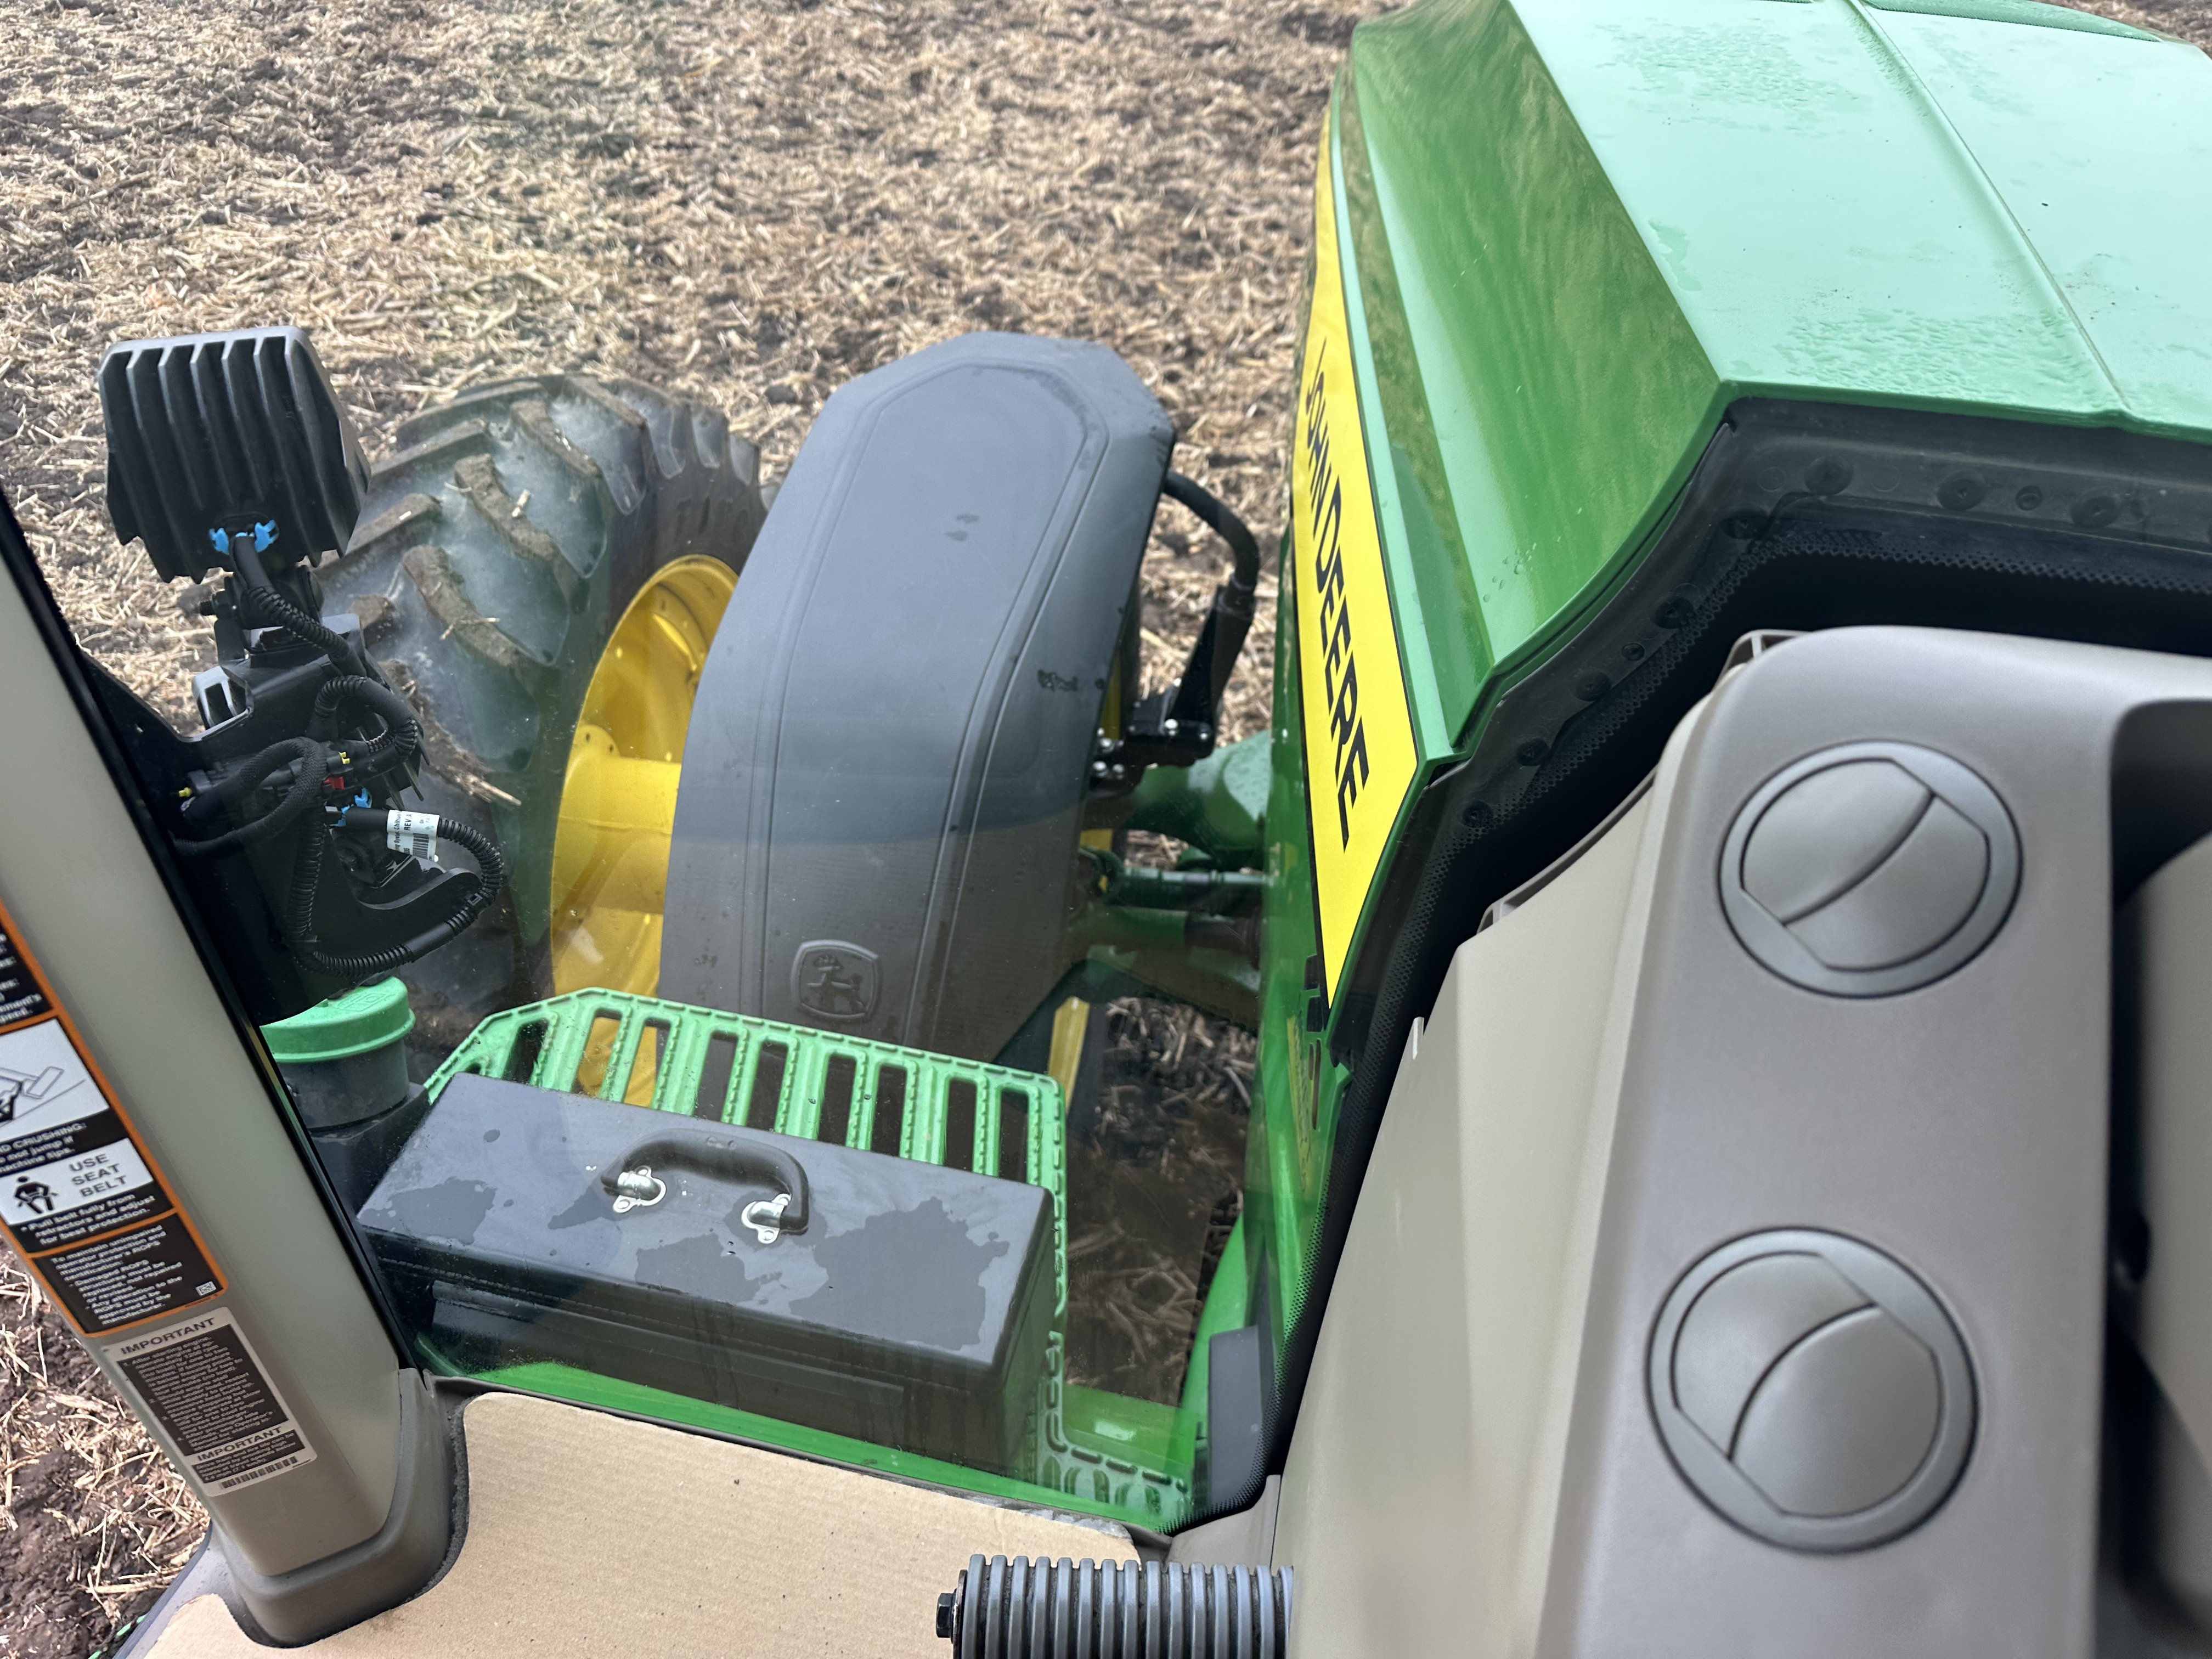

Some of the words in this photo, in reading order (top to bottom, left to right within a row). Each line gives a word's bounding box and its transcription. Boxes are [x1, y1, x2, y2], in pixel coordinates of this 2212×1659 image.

[1306, 336, 1331, 540] JOHN
[1316, 475, 1369, 853] DEERE
[13, 1123, 87, 1148] CRUSHING:
[7, 1150, 28, 1161] not
[30, 1140, 63, 1156] jump
[69, 1153, 110, 1172] USE
[71, 1163, 120, 1185] SEAT
[80, 1175, 127, 1197] BELT
[28, 1219, 53, 1230] Pull
[53, 1212, 78, 1223] belt
[78, 1204, 105, 1215] fully
[106, 1194, 135, 1206] from
[36, 1217, 93, 1237] retractors
[95, 1208, 117, 1220] and
[119, 1195, 155, 1212] adjust
[40, 1236, 57, 1244] for
[59, 1227, 86, 1239] best
[88, 1209, 149, 1232] protection.
[56, 1255, 96, 1269] operator
[98, 1239, 146, 1257] protection
[148, 1231, 166, 1240] and
[67, 1244, 108, 1259] maintain
[109, 1225, 162, 1246] unimpaired
[60, 1251, 131, 1275] manufacturer's
[132, 1240, 160, 1253] ROPS
[75, 1269, 120, 1286] Damaged
[120, 1260, 149, 1272] ROPS
[78, 1275, 126, 1291] structures
[128, 1266, 151, 1276] must
[82, 1282, 126, 1297] replaced,
[144, 1262, 182, 1278] repaired
[91, 1300, 110, 1308] Any
[112, 1286, 155, 1302] alteration
[94, 1302, 122, 1313] ROPS
[123, 1294, 147, 1305] must
[99, 1285, 134, 1299] revised.
[98, 1303, 142, 1319] approved
[102, 1303, 161, 1324] manufacturer.
[121, 1318, 213, 1354] IMPORTANT
[198, 1426, 280, 1460] IMPORTANT
